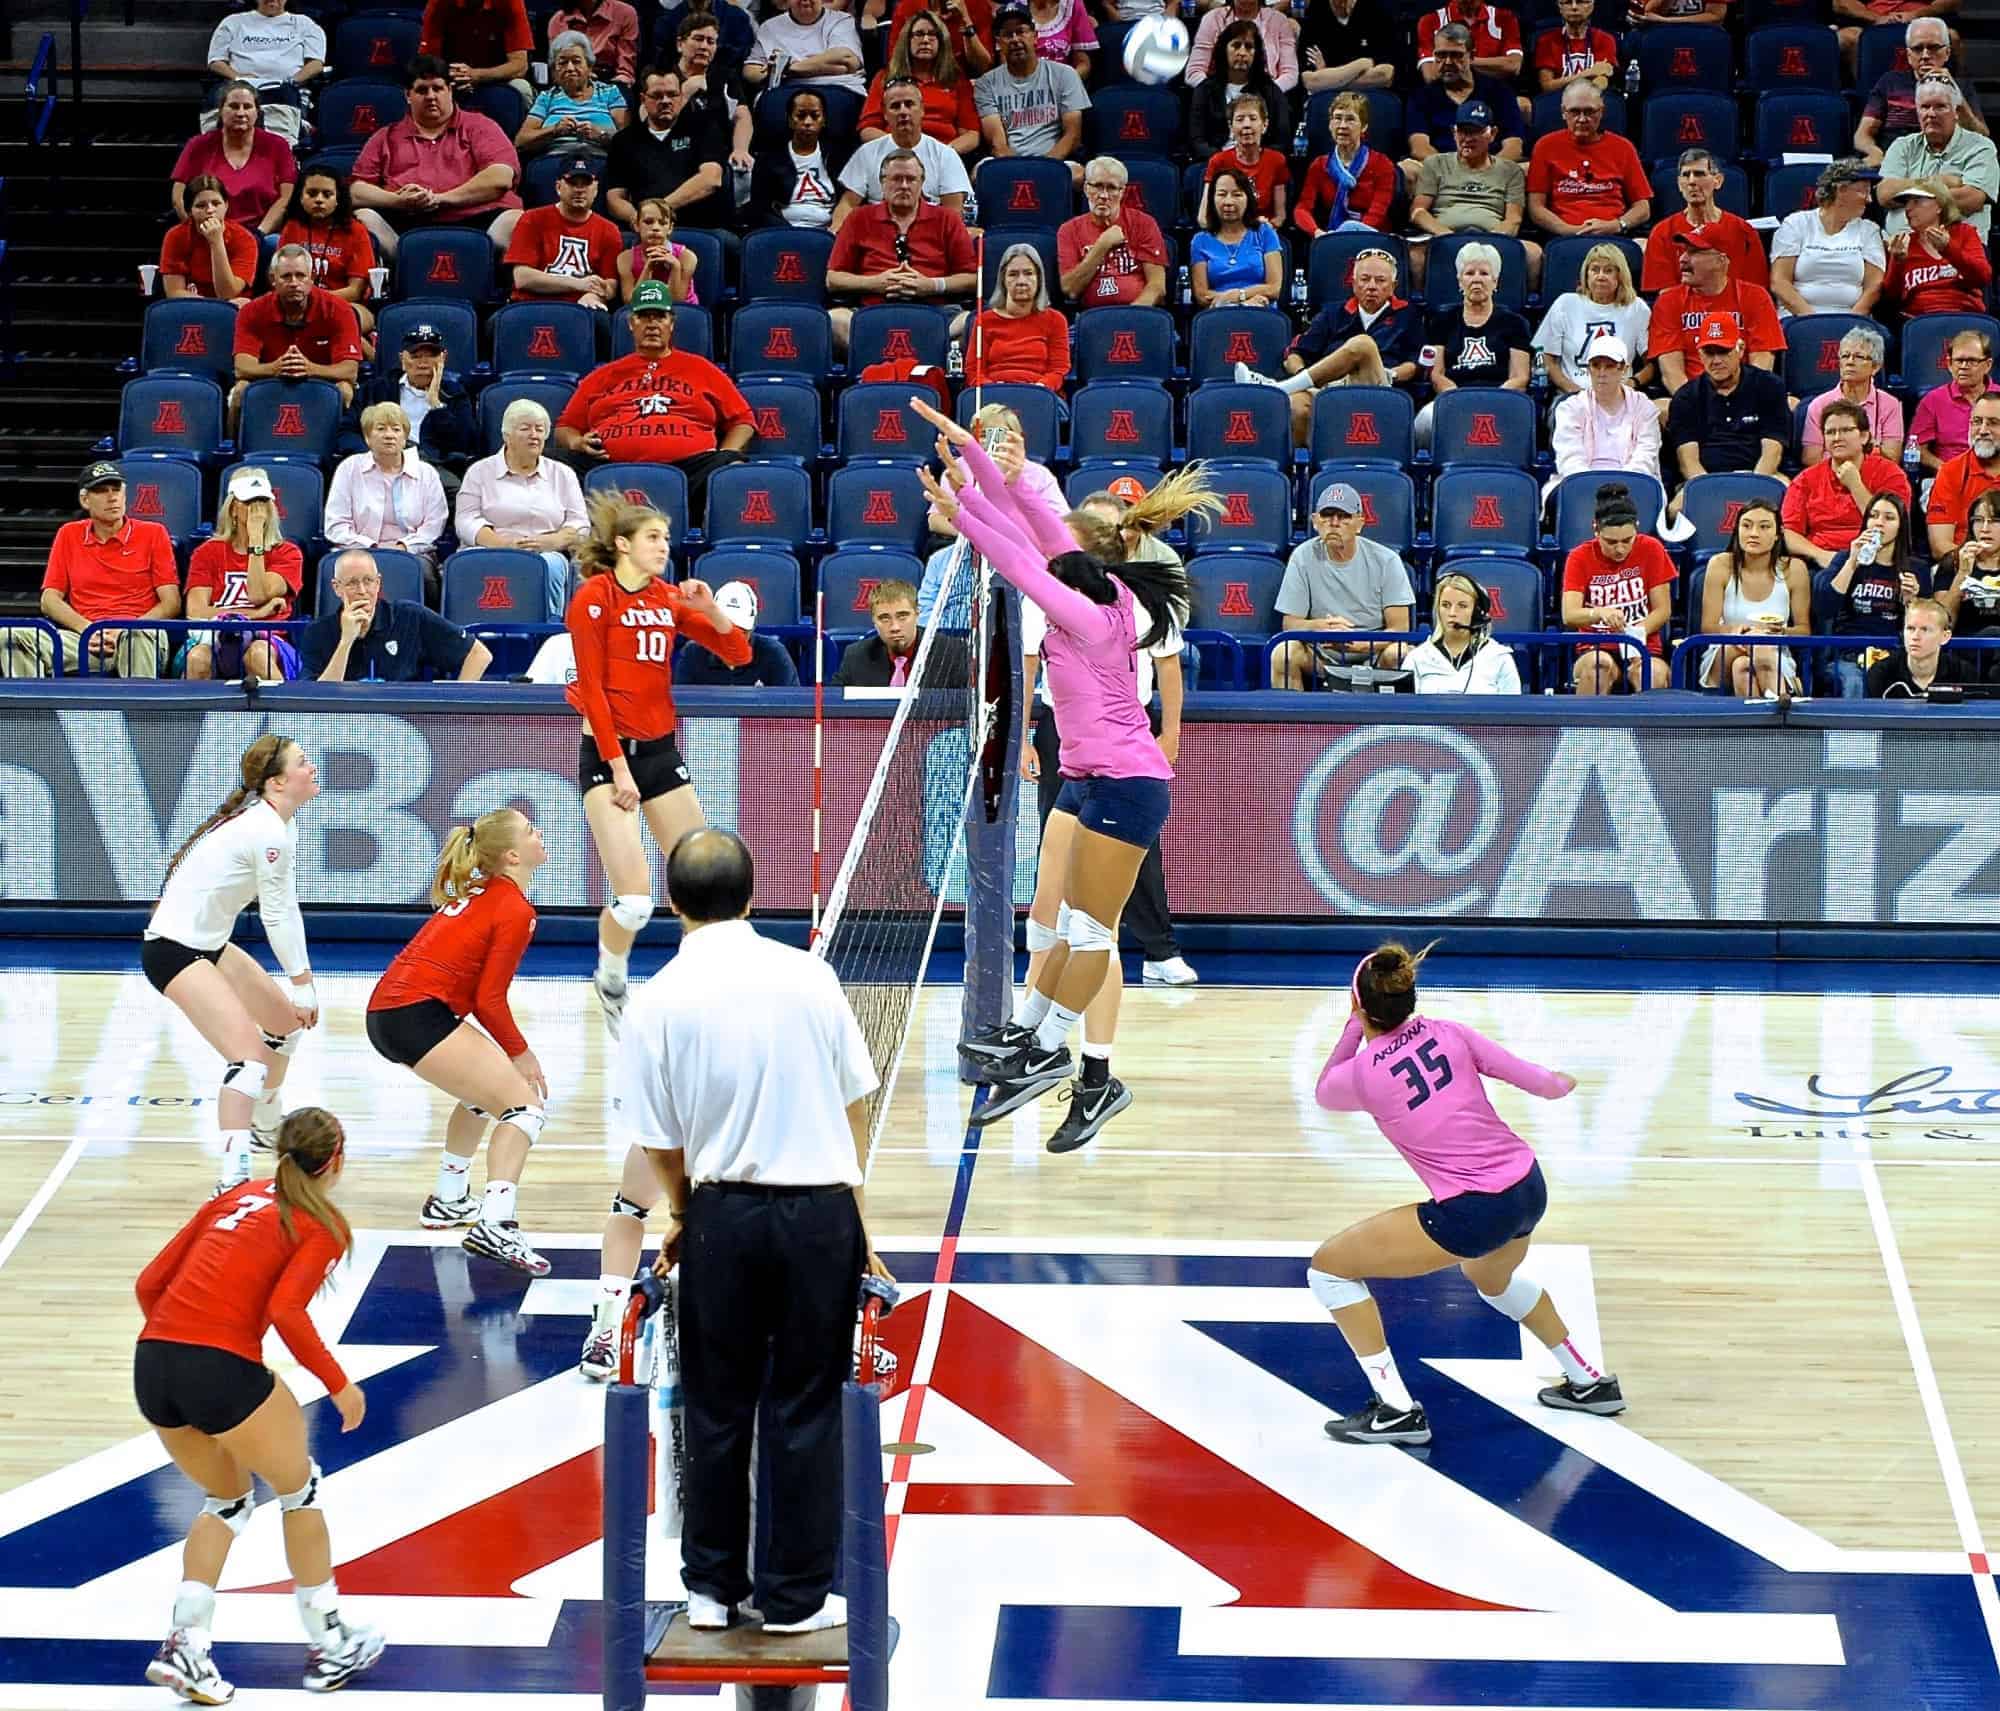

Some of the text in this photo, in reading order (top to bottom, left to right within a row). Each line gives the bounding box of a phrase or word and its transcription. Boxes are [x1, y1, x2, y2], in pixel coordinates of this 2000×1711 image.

[545, 235, 593, 278] A
[1097, 276, 1119, 297] A
[1457, 336, 1497, 366] A
[601, 423, 695, 439] OOTBALL
[1589, 577, 1645, 607] BEAR
[620, 607, 676, 628] UTAH
[636, 630, 667, 662] 10
[1372, 1021, 1427, 1067] ARIZONA
[1389, 1038, 1453, 1111] 35
[1923, 1128, 1985, 1141] &
[215, 1194, 275, 1232] 7
